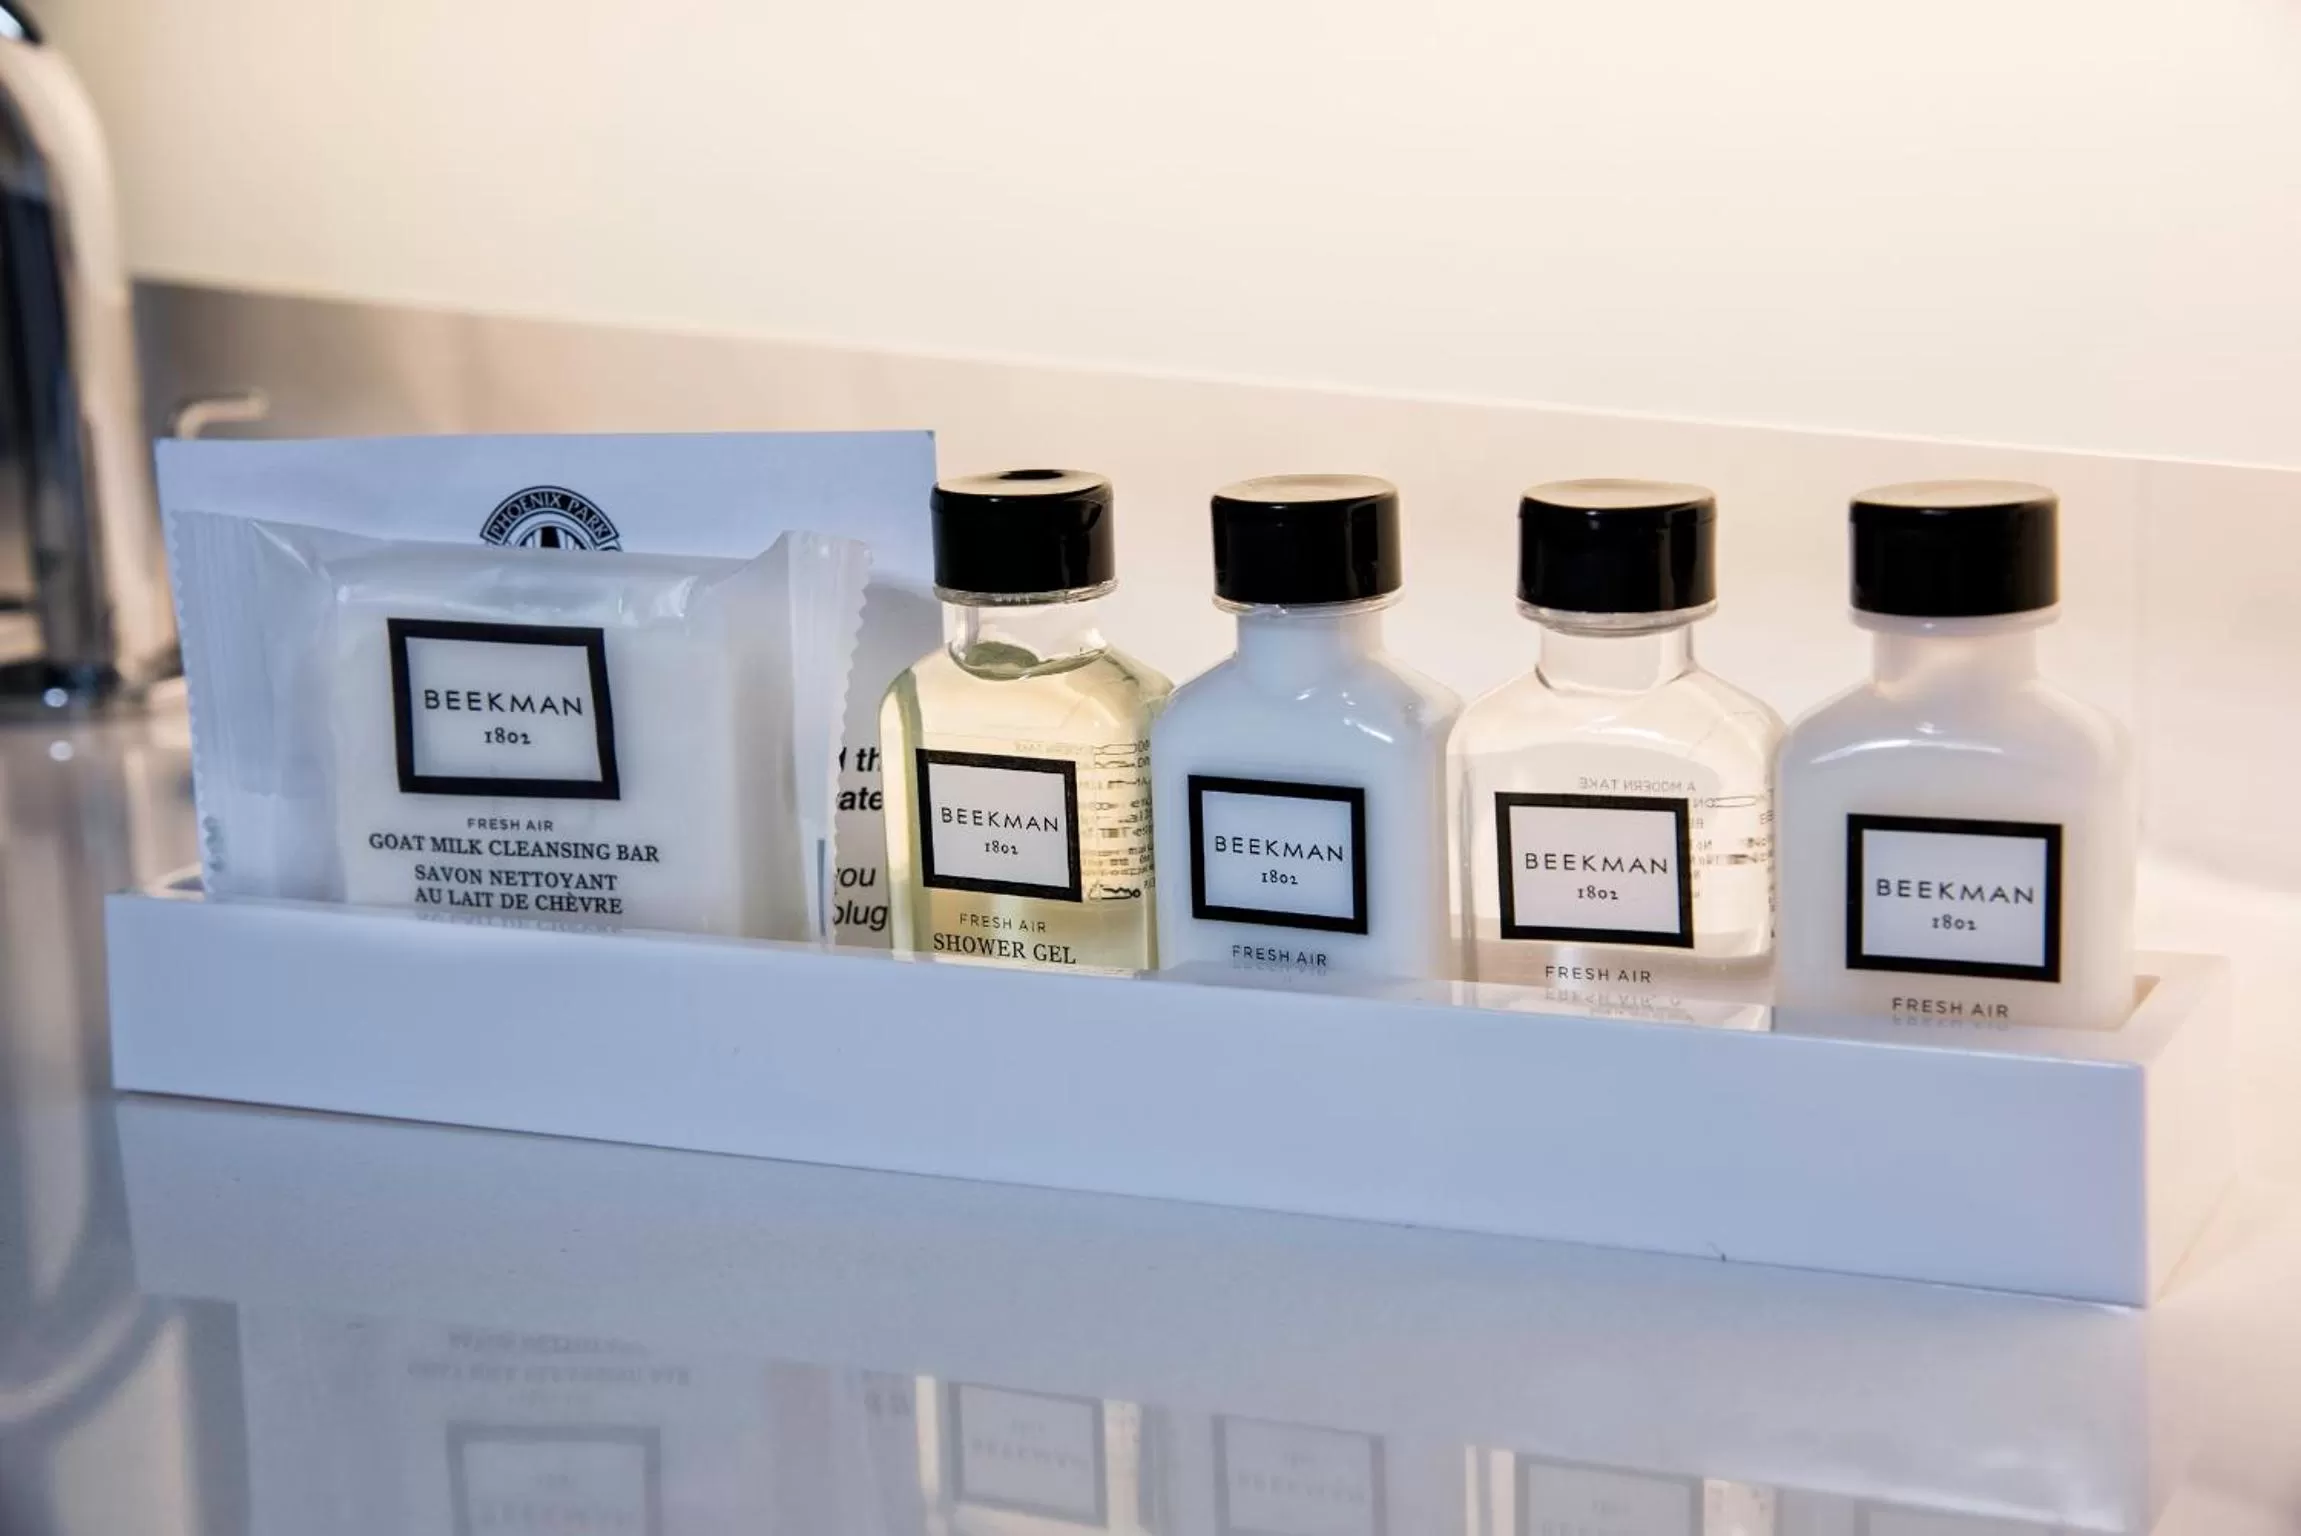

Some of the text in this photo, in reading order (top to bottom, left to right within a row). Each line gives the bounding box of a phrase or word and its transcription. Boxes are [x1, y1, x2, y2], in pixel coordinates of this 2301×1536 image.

[489, 491, 609, 538] PHOENIX PARK
[424, 689, 583, 716] BEEKMAN
[484, 726, 531, 745] 1802
[467, 818, 554, 832] FRESH AIR
[941, 807, 1058, 832] BEEKMAN
[369, 833, 660, 863] GOAT MILK CLEANSING BAR
[985, 840, 1019, 855] 1802
[1215, 835, 1343, 861] BEEKMAN
[1525, 853, 1668, 875] BEEKMAN
[415, 865, 618, 891] SAVON NETTOYANT
[1261, 869, 1298, 885] 1802
[415, 887, 624, 914] AU LAIT DE CHÈVRE
[1577, 885, 1619, 900] 1802
[1876, 878, 2034, 904] BEEKMAN
[959, 913, 1047, 933] FRESH AIR
[1931, 914, 1977, 931] 1802
[933, 932, 1077, 965] SHOWER GEL
[1232, 944, 1327, 966] FRESH AIR
[1545, 966, 1651, 983] FRESH AIR
[1891, 997, 2009, 1018] FRESH AIR
